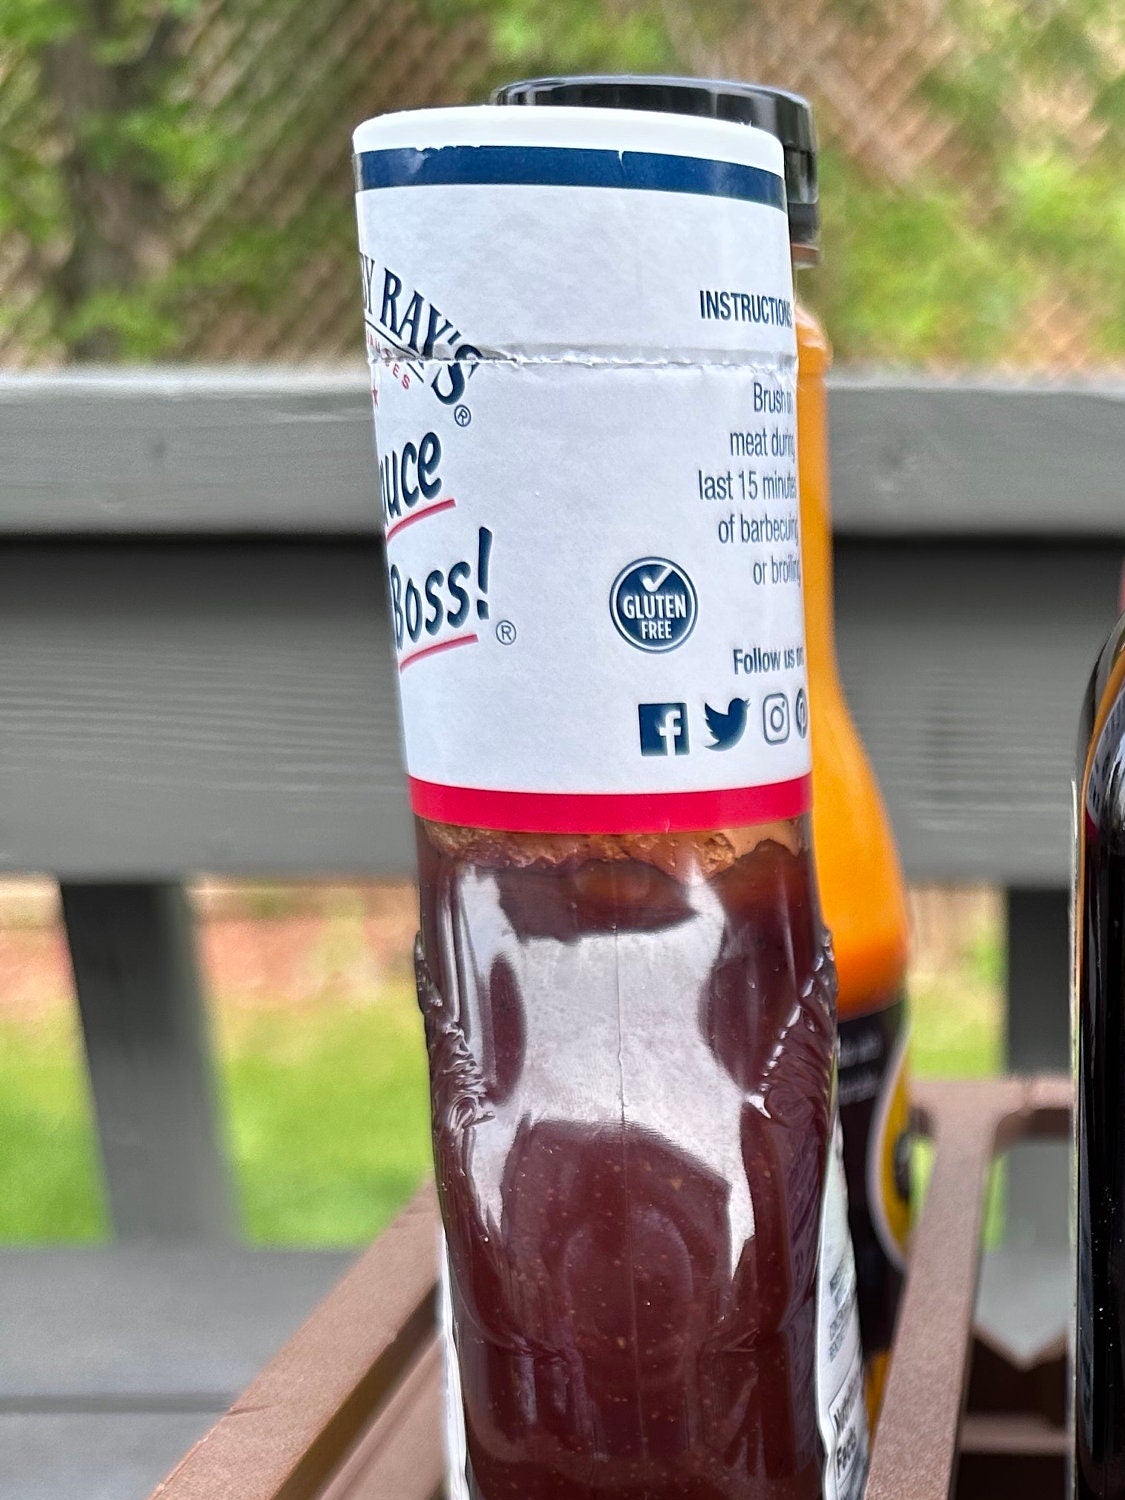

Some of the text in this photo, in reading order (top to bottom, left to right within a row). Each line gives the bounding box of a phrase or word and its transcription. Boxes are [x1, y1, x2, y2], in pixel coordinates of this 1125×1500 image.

[380, 267, 484, 405] RAY'S
[754, 382, 785, 414] Brush
[730, 427, 768, 457] meat
[698, 470, 733, 501] last
[738, 470, 758, 501] 15
[718, 514, 736, 544] of
[753, 561, 768, 585] or
[622, 593, 687, 620] GLUTEN
[641, 621, 673, 640] FREE
[733, 647, 781, 675] Follow
[784, 648, 796, 670] us
